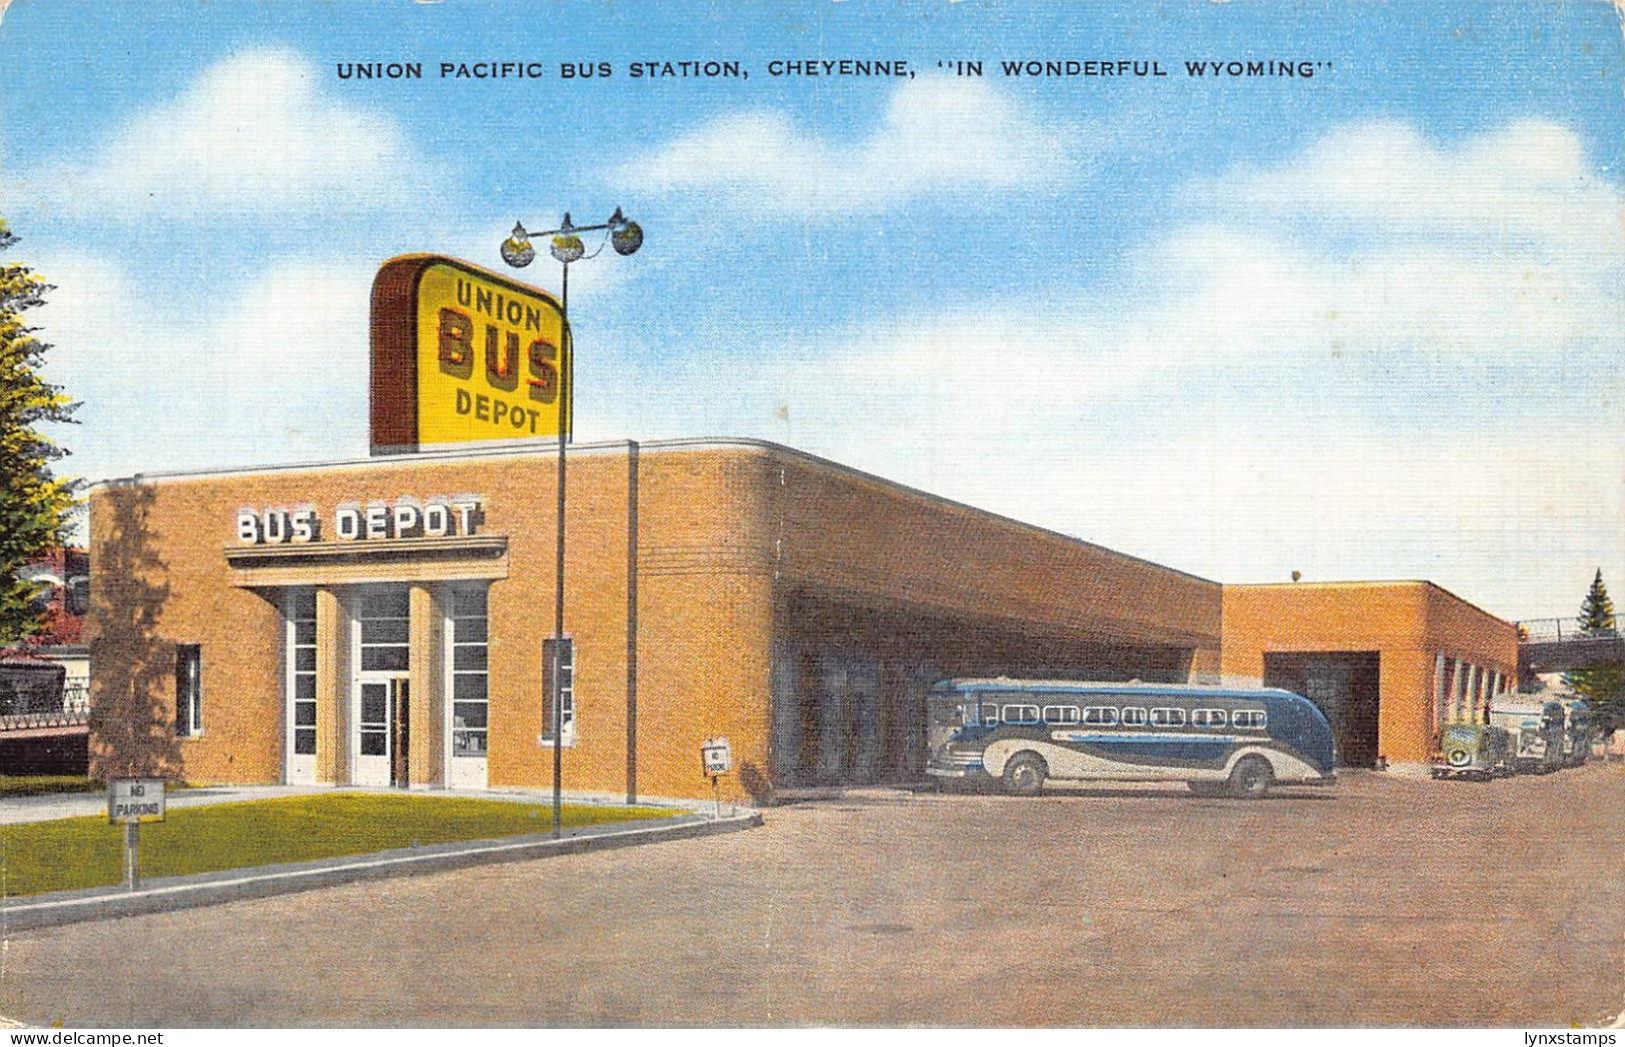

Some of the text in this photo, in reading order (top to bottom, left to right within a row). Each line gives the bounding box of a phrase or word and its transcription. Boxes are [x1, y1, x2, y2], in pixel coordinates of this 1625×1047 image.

[337, 63, 421, 79] UNION
[440, 62, 542, 79] PACIFIC
[561, 62, 612, 78] BUS
[629, 61, 749, 80] STATION,
[768, 60, 916, 79] CHEYENNE,
[1002, 60, 1167, 76] WONDERFUL
[457, 278, 541, 332] UNION
[438, 307, 558, 405] BUS
[456, 388, 540, 434] DEPOT
[237, 498, 483, 544] BUS DEPOT
[116, 803, 159, 816] PARKING
[131, 785, 145, 797] NO
